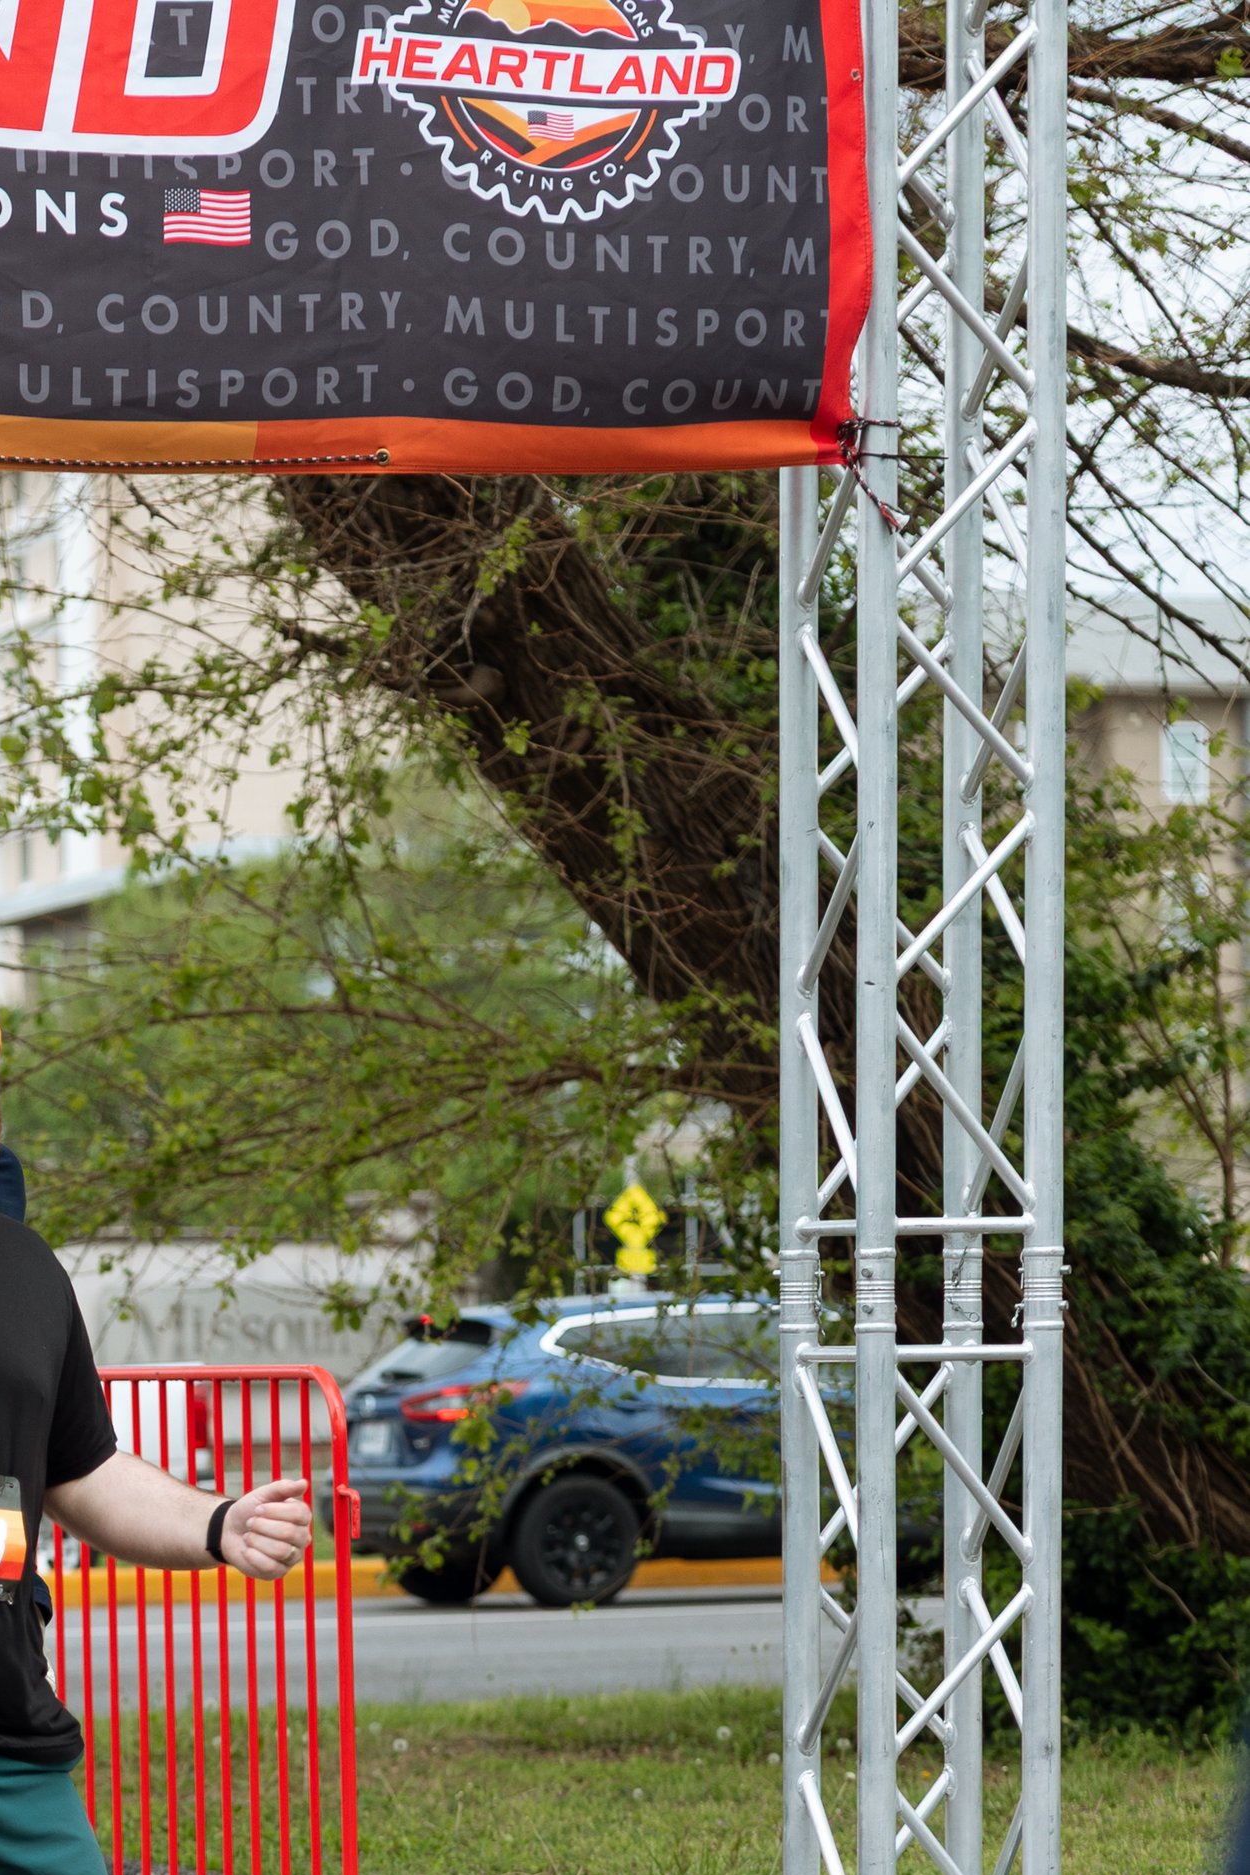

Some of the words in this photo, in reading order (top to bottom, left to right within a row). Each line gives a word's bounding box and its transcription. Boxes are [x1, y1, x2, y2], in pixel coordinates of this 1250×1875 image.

[359, 35, 735, 97] HEARTLAND
[480, 149, 574, 192] RACING
[589, 162, 624, 184] CO.
[265, 219, 410, 262] GOD,
[443, 223, 755, 278] COUNTRY,
[96, 290, 412, 336] COUNTRY,
[443, 368, 591, 417] GOD,
[621, 377, 823, 416] COUNT
